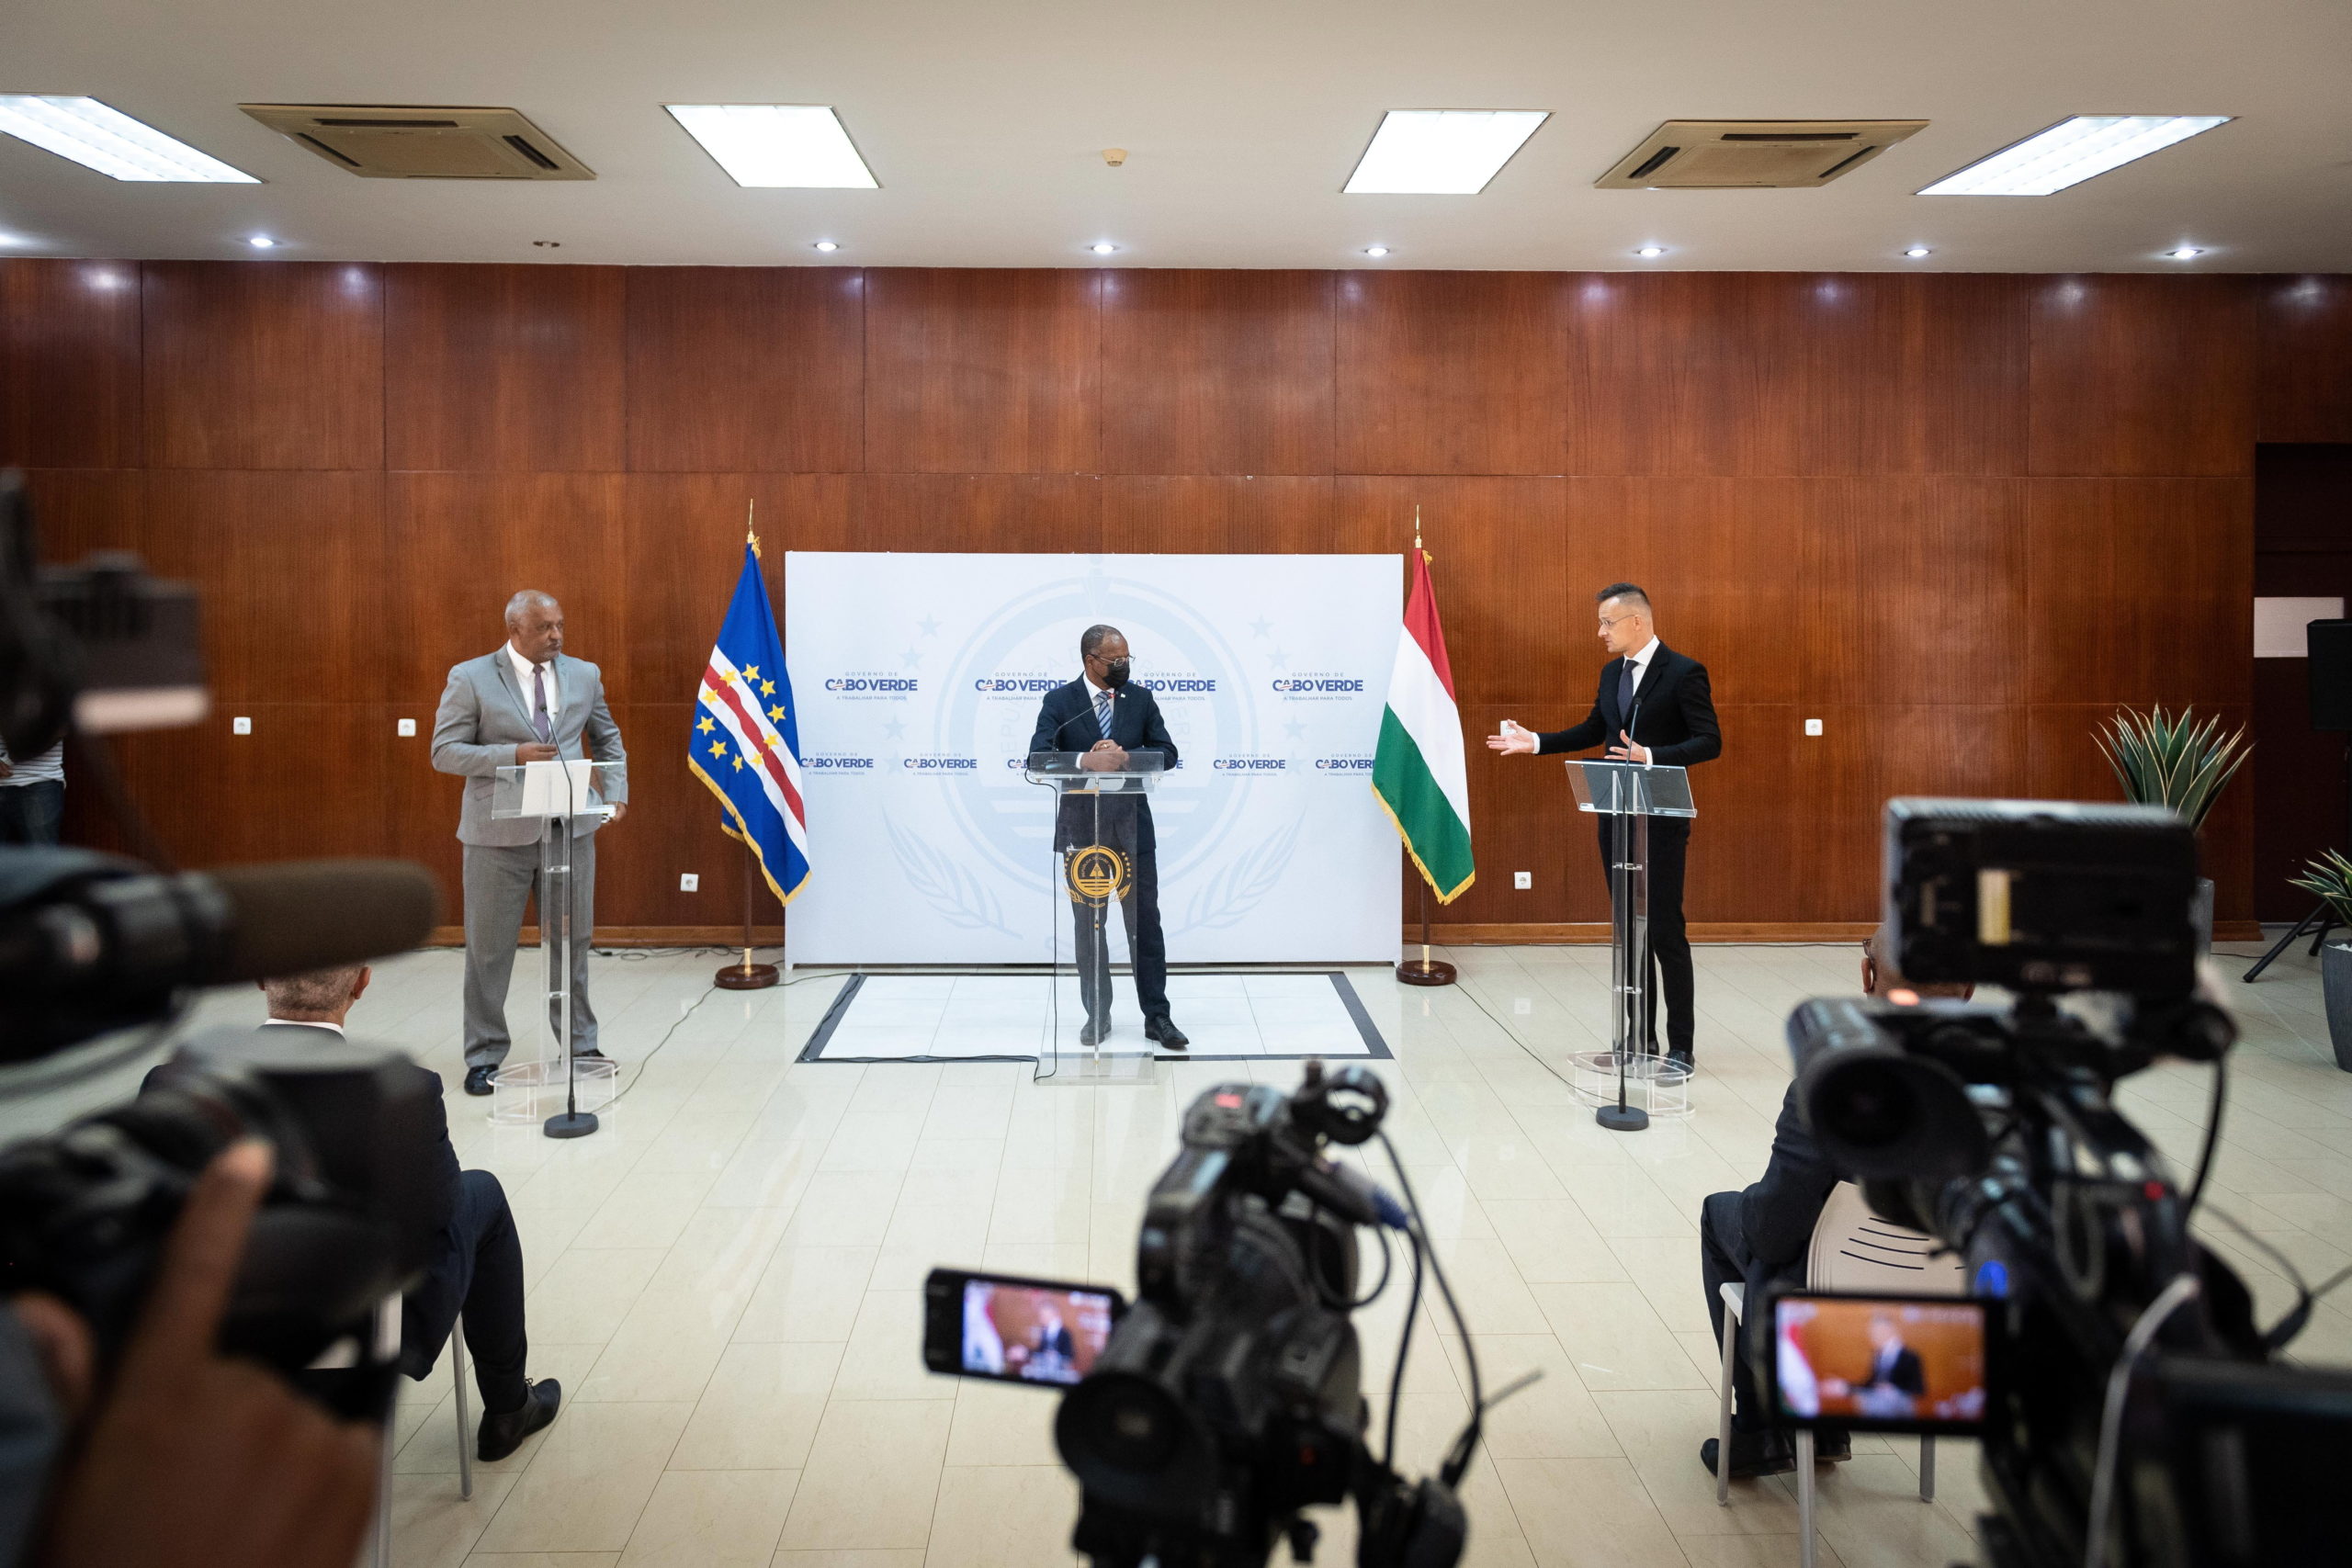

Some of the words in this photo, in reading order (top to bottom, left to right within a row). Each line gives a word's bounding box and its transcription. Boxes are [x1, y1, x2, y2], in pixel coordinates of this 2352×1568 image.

[824, 678, 867, 692] CABO
[867, 678, 918, 692] VERDE
[975, 679, 1017, 692] CABO
[1128, 679, 1166, 692] ABO
[1167, 679, 1216, 692] VERDE
[1272, 679, 1314, 692] CABO
[1314, 679, 1363, 692] VERDE
[800, 758, 833, 768] CABO
[834, 758, 874, 768] VERDE
[903, 758, 937, 769] CABO
[938, 759, 978, 769] VERDE
[1213, 759, 1247, 770] CABO
[1247, 759, 1286, 770] VERDE
[1315, 759, 1349, 769] CABO
